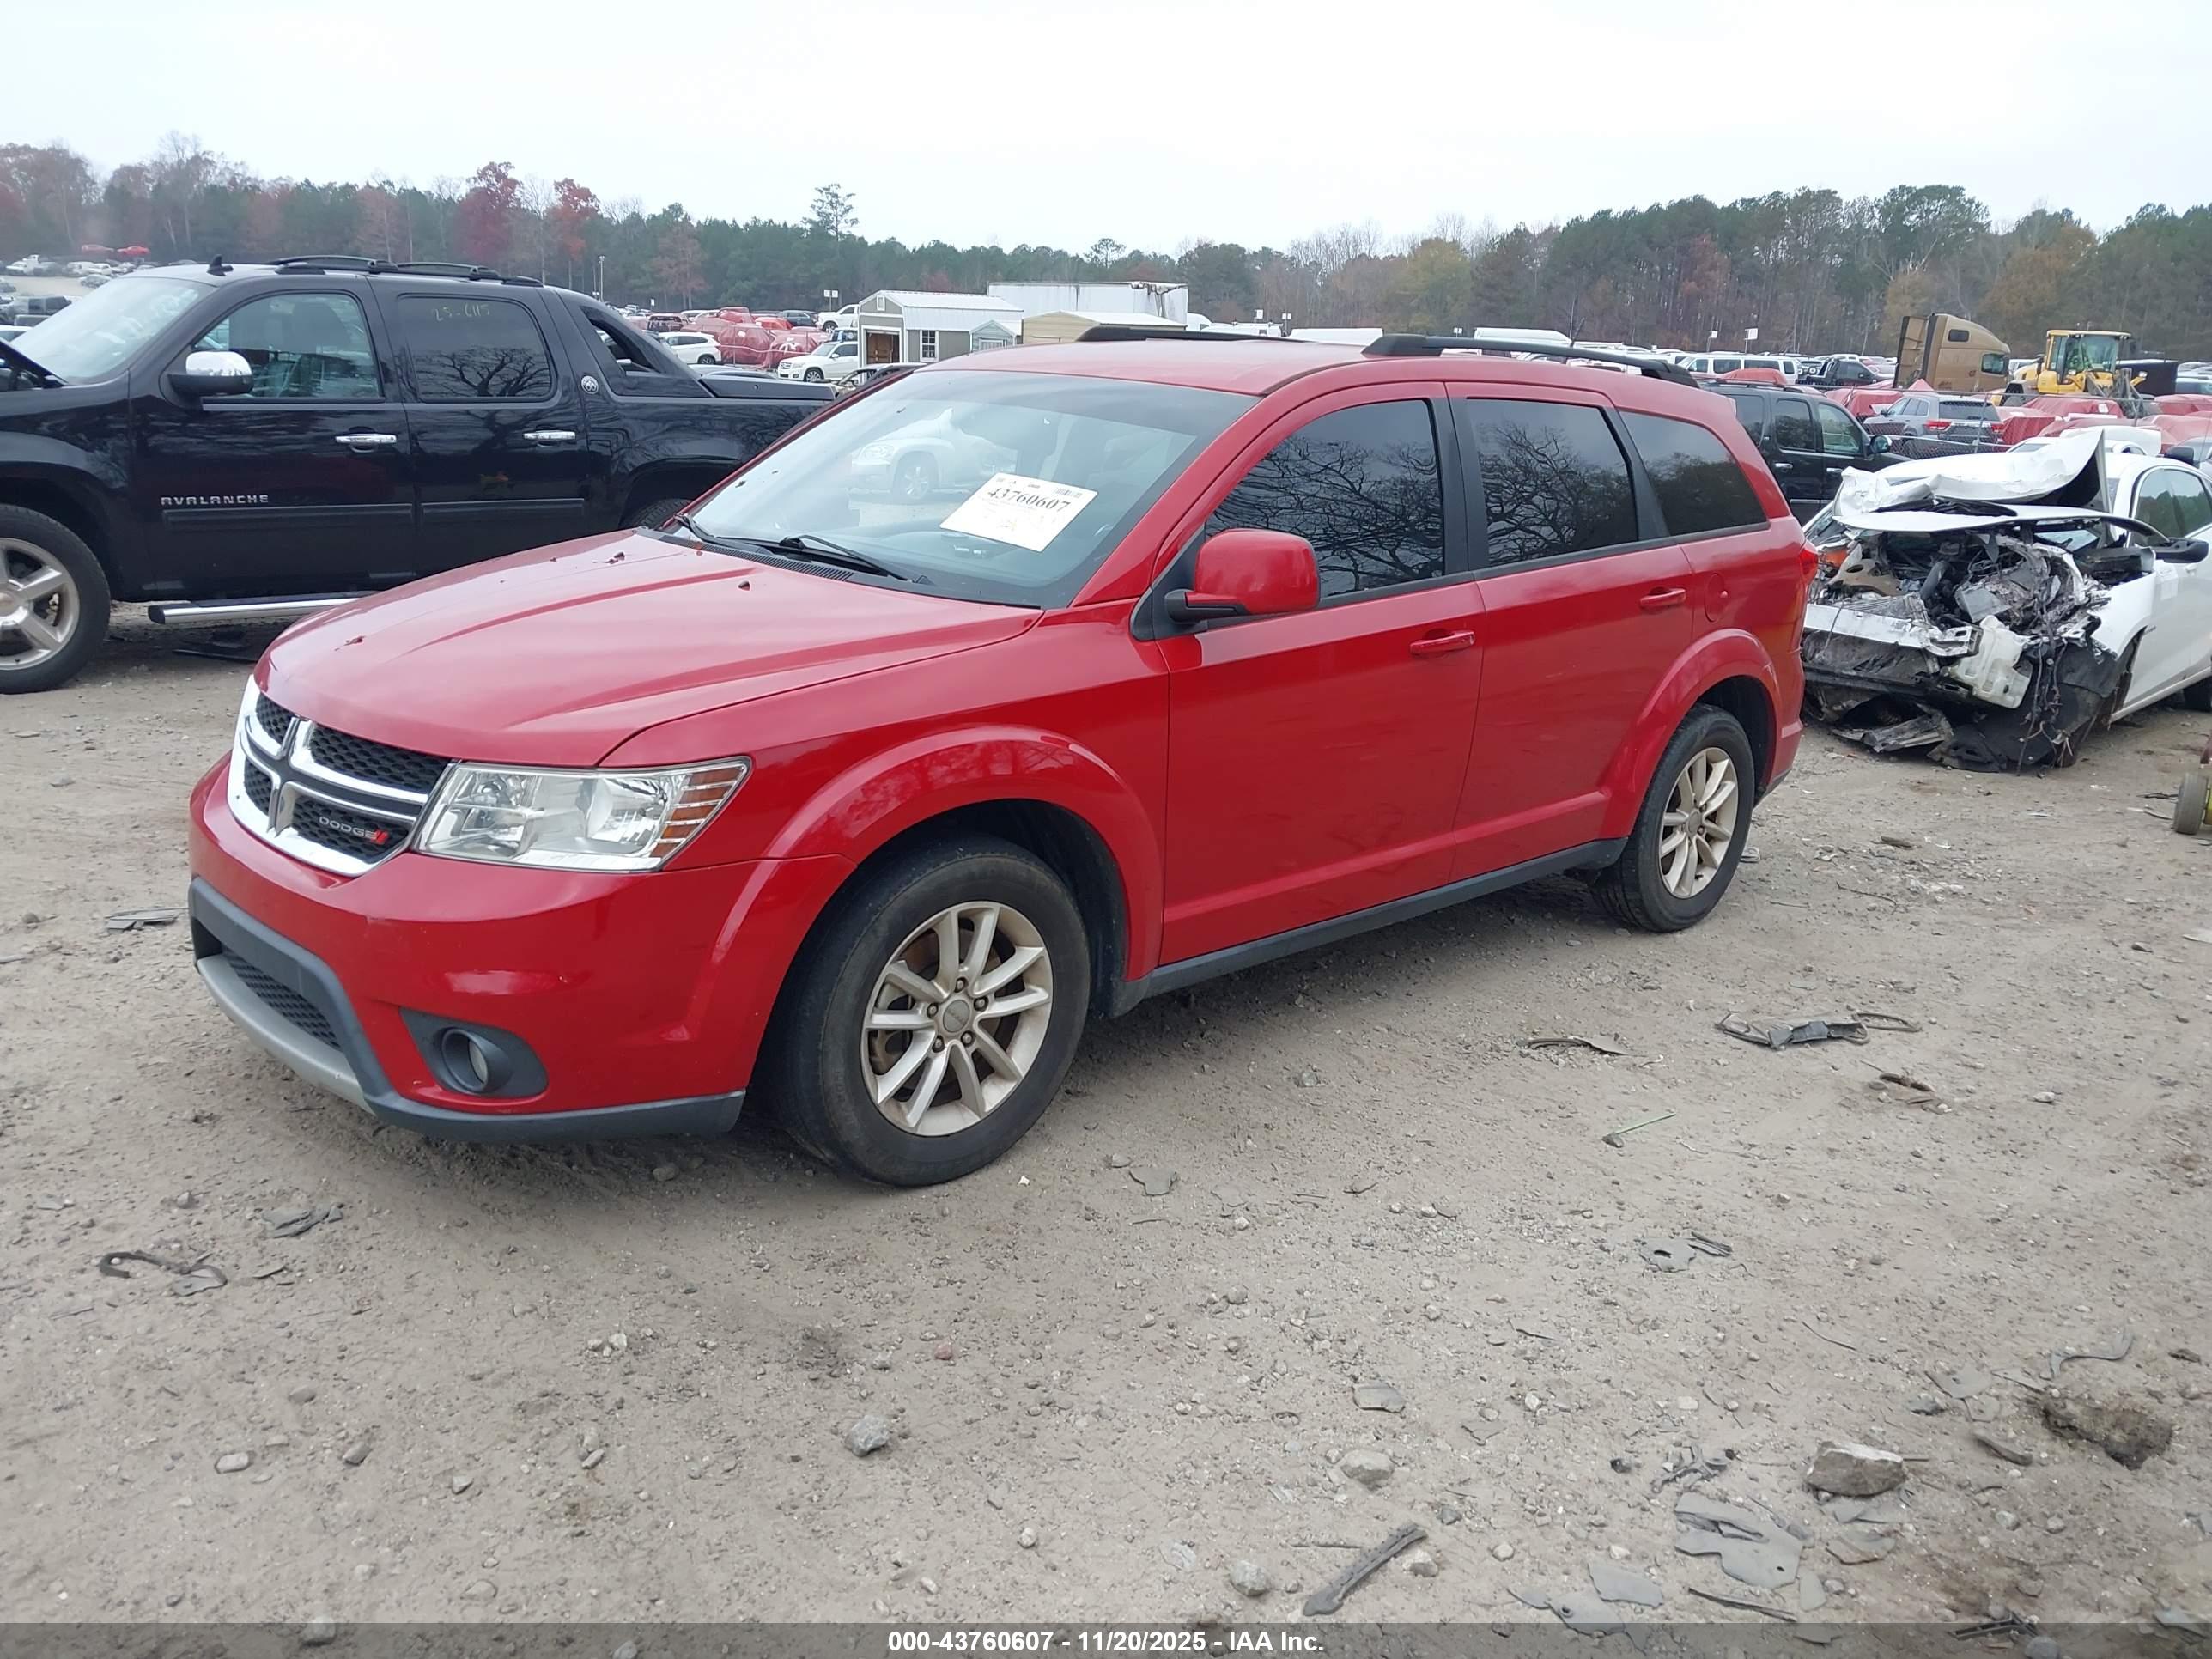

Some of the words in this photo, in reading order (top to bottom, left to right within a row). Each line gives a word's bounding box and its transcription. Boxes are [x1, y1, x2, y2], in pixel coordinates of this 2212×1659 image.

[161, 495, 269, 505] AVALANCHE
[988, 487, 1071, 512] 43760607
[319, 816, 378, 841] DODGE
